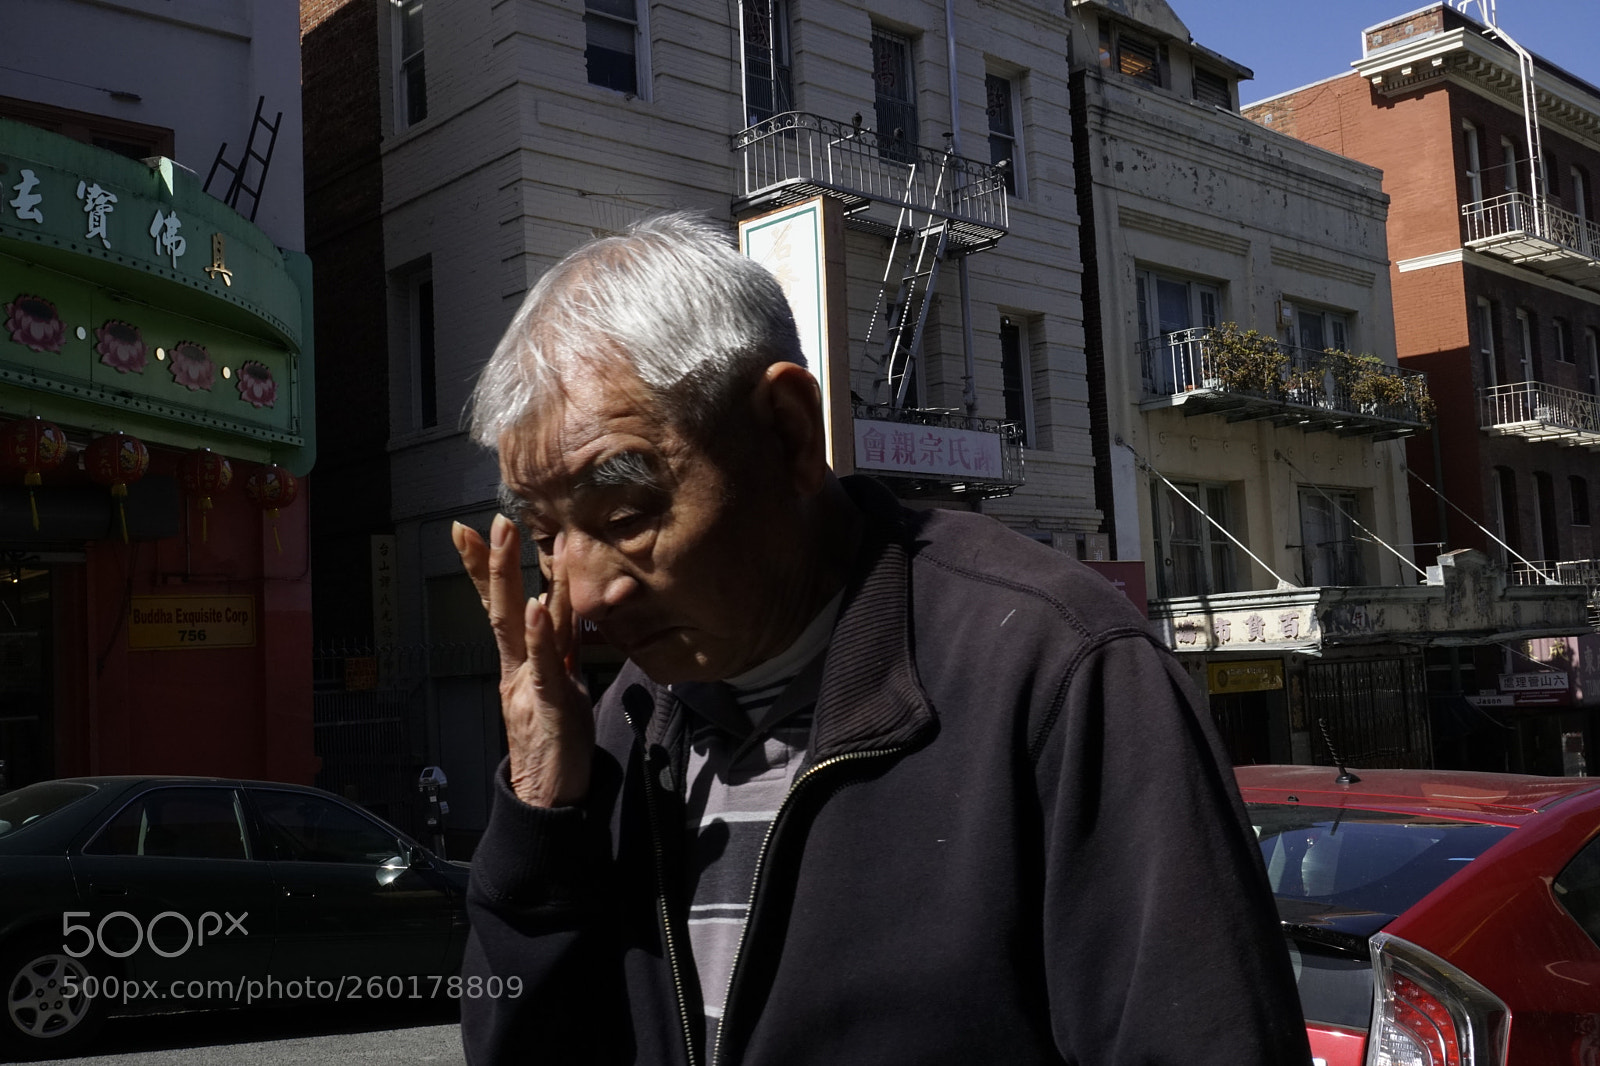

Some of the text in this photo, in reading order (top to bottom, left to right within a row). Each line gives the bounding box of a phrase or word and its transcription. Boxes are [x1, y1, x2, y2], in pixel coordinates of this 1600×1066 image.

[133, 607, 249, 627] Buddha Exquisite Corp
[178, 629, 207, 642] 756
